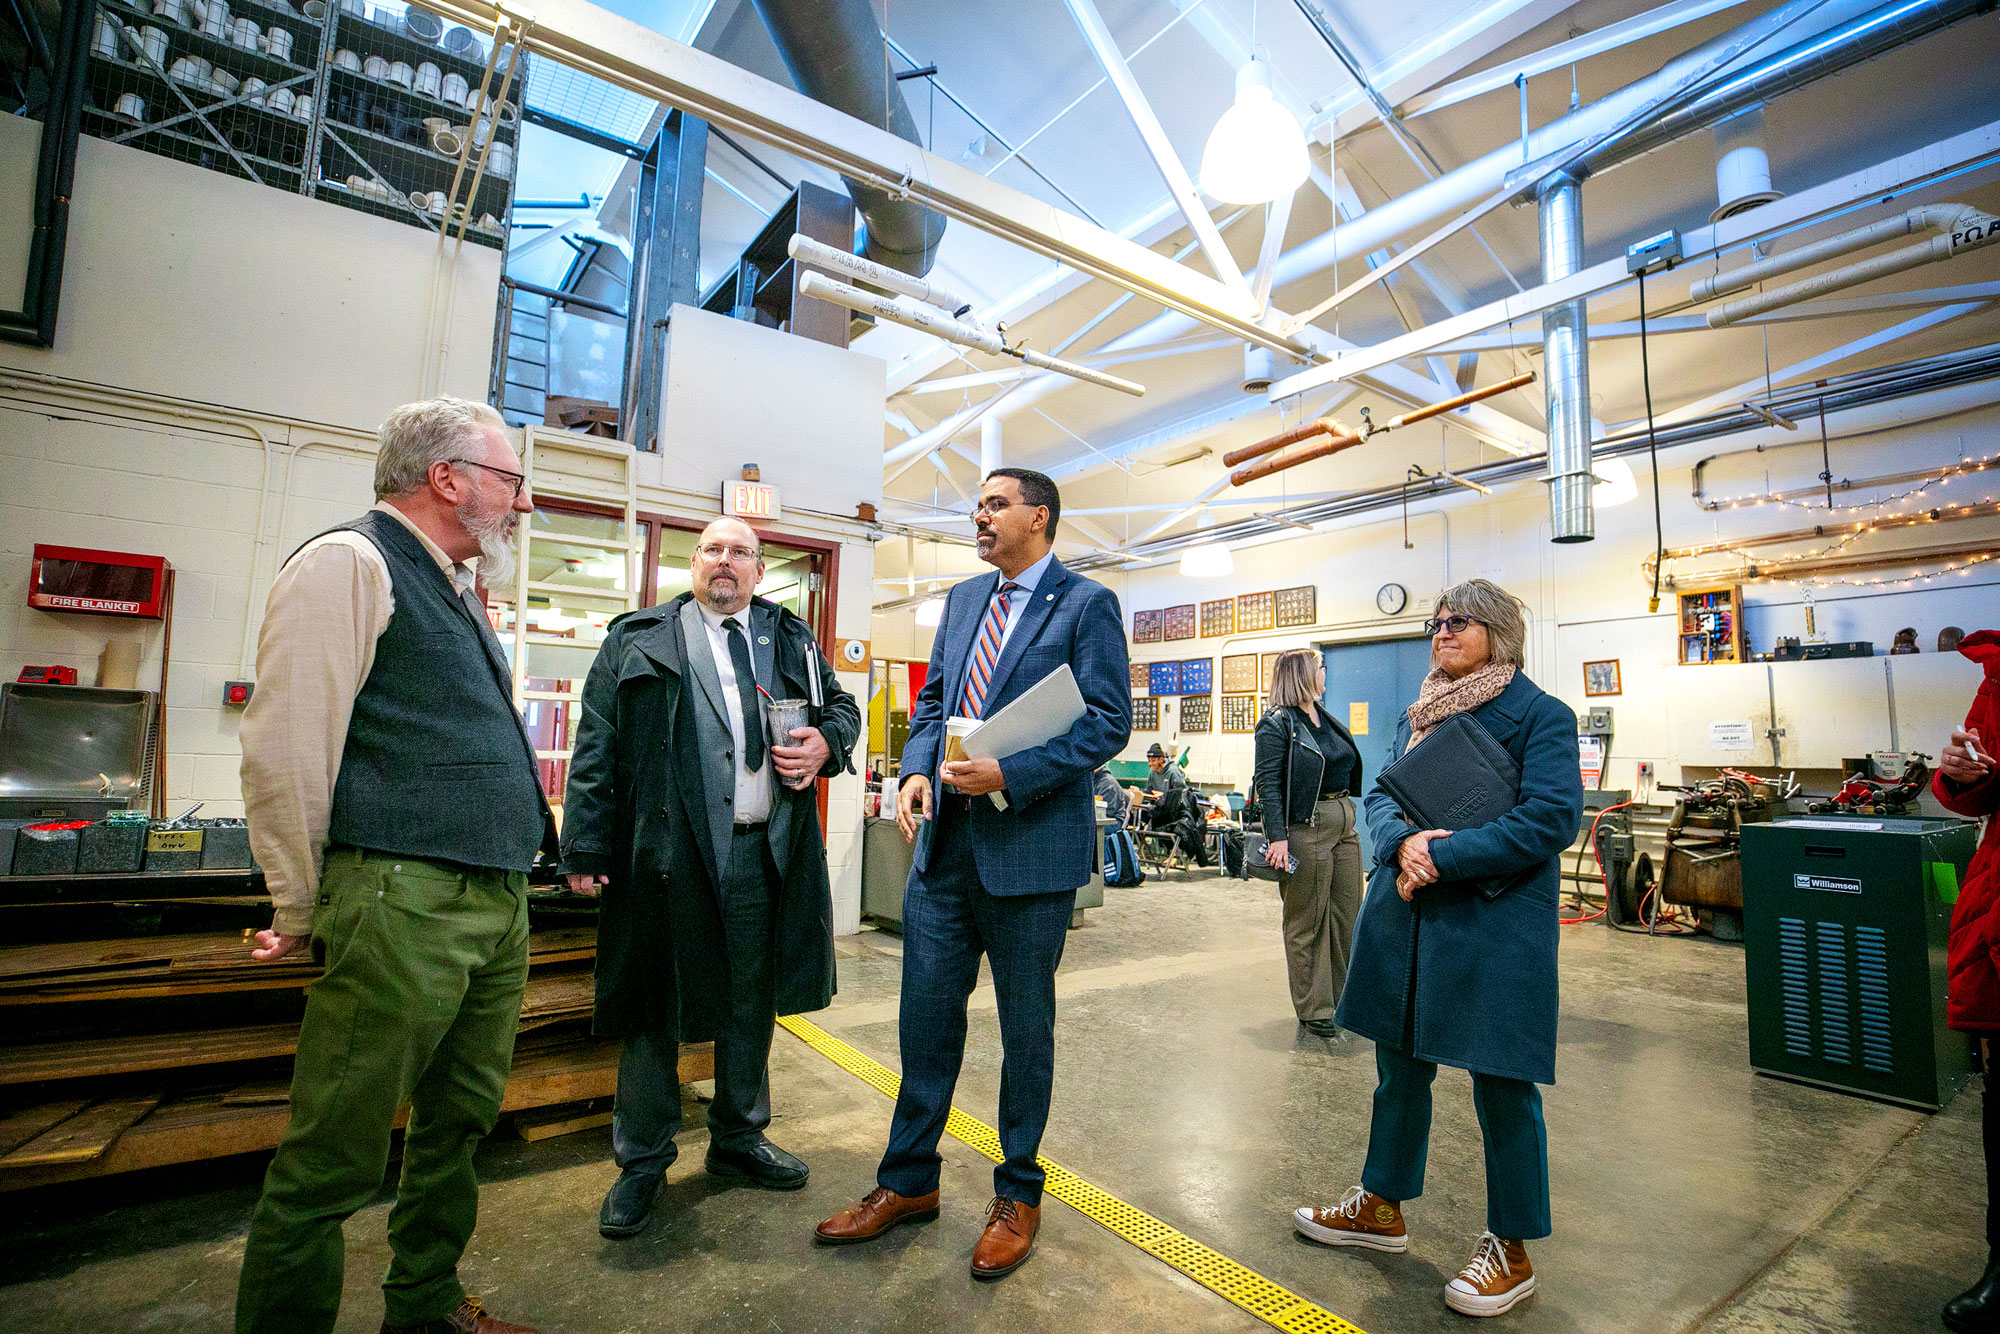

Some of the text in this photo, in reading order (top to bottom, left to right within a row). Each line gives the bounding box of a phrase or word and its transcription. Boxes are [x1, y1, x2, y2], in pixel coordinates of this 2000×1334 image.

[830, 249, 879, 279] TEAM 2
[886, 268, 903, 280] PAUL
[873, 304, 901, 319] MARTIN
[735, 484, 773, 516] EXIT
[52, 597, 137, 611] FIRE BLANKET
[1811, 879, 1859, 891] Williamson
